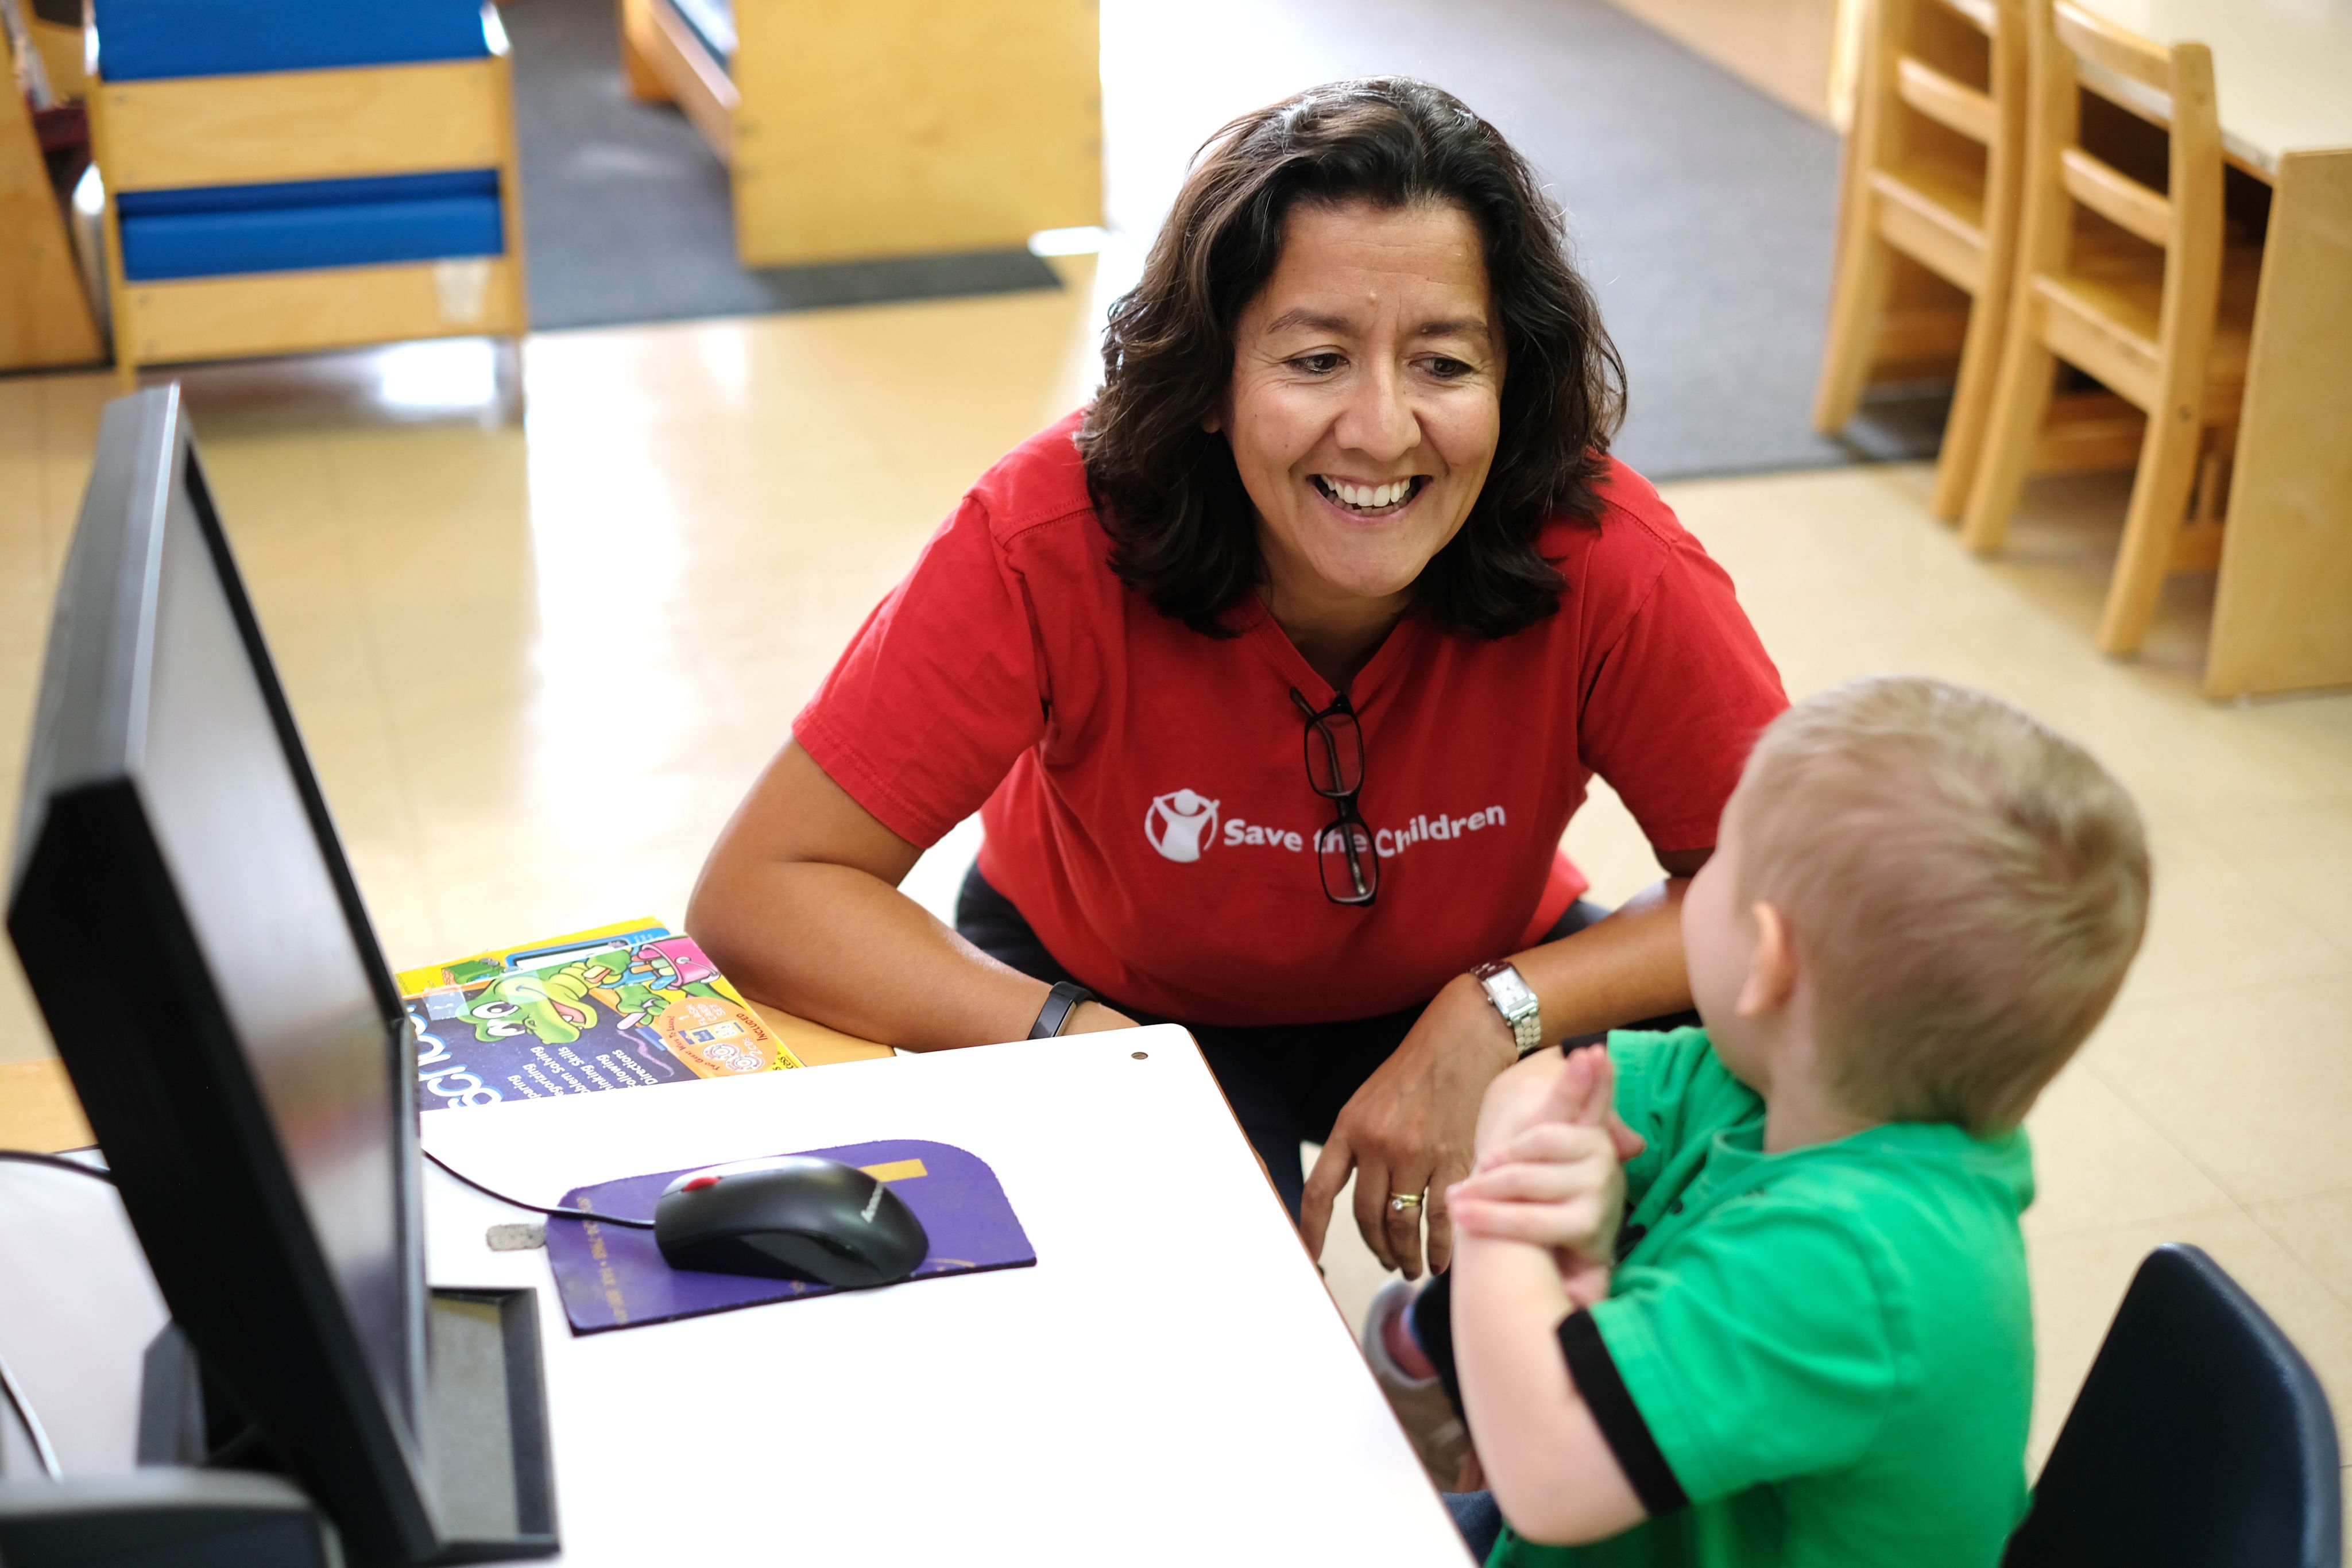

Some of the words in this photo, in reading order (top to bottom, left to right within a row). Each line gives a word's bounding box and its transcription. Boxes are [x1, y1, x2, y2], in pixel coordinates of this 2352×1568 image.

[1223, 818, 1303, 852] Save
[1313, 828, 1368, 854] the
[1375, 805, 1507, 858] Children
[529, 1046, 565, 1074] Solving
[558, 1046, 585, 1067] Skills
[612, 1049, 659, 1085] Directions
[580, 1064, 616, 1091] hinking
